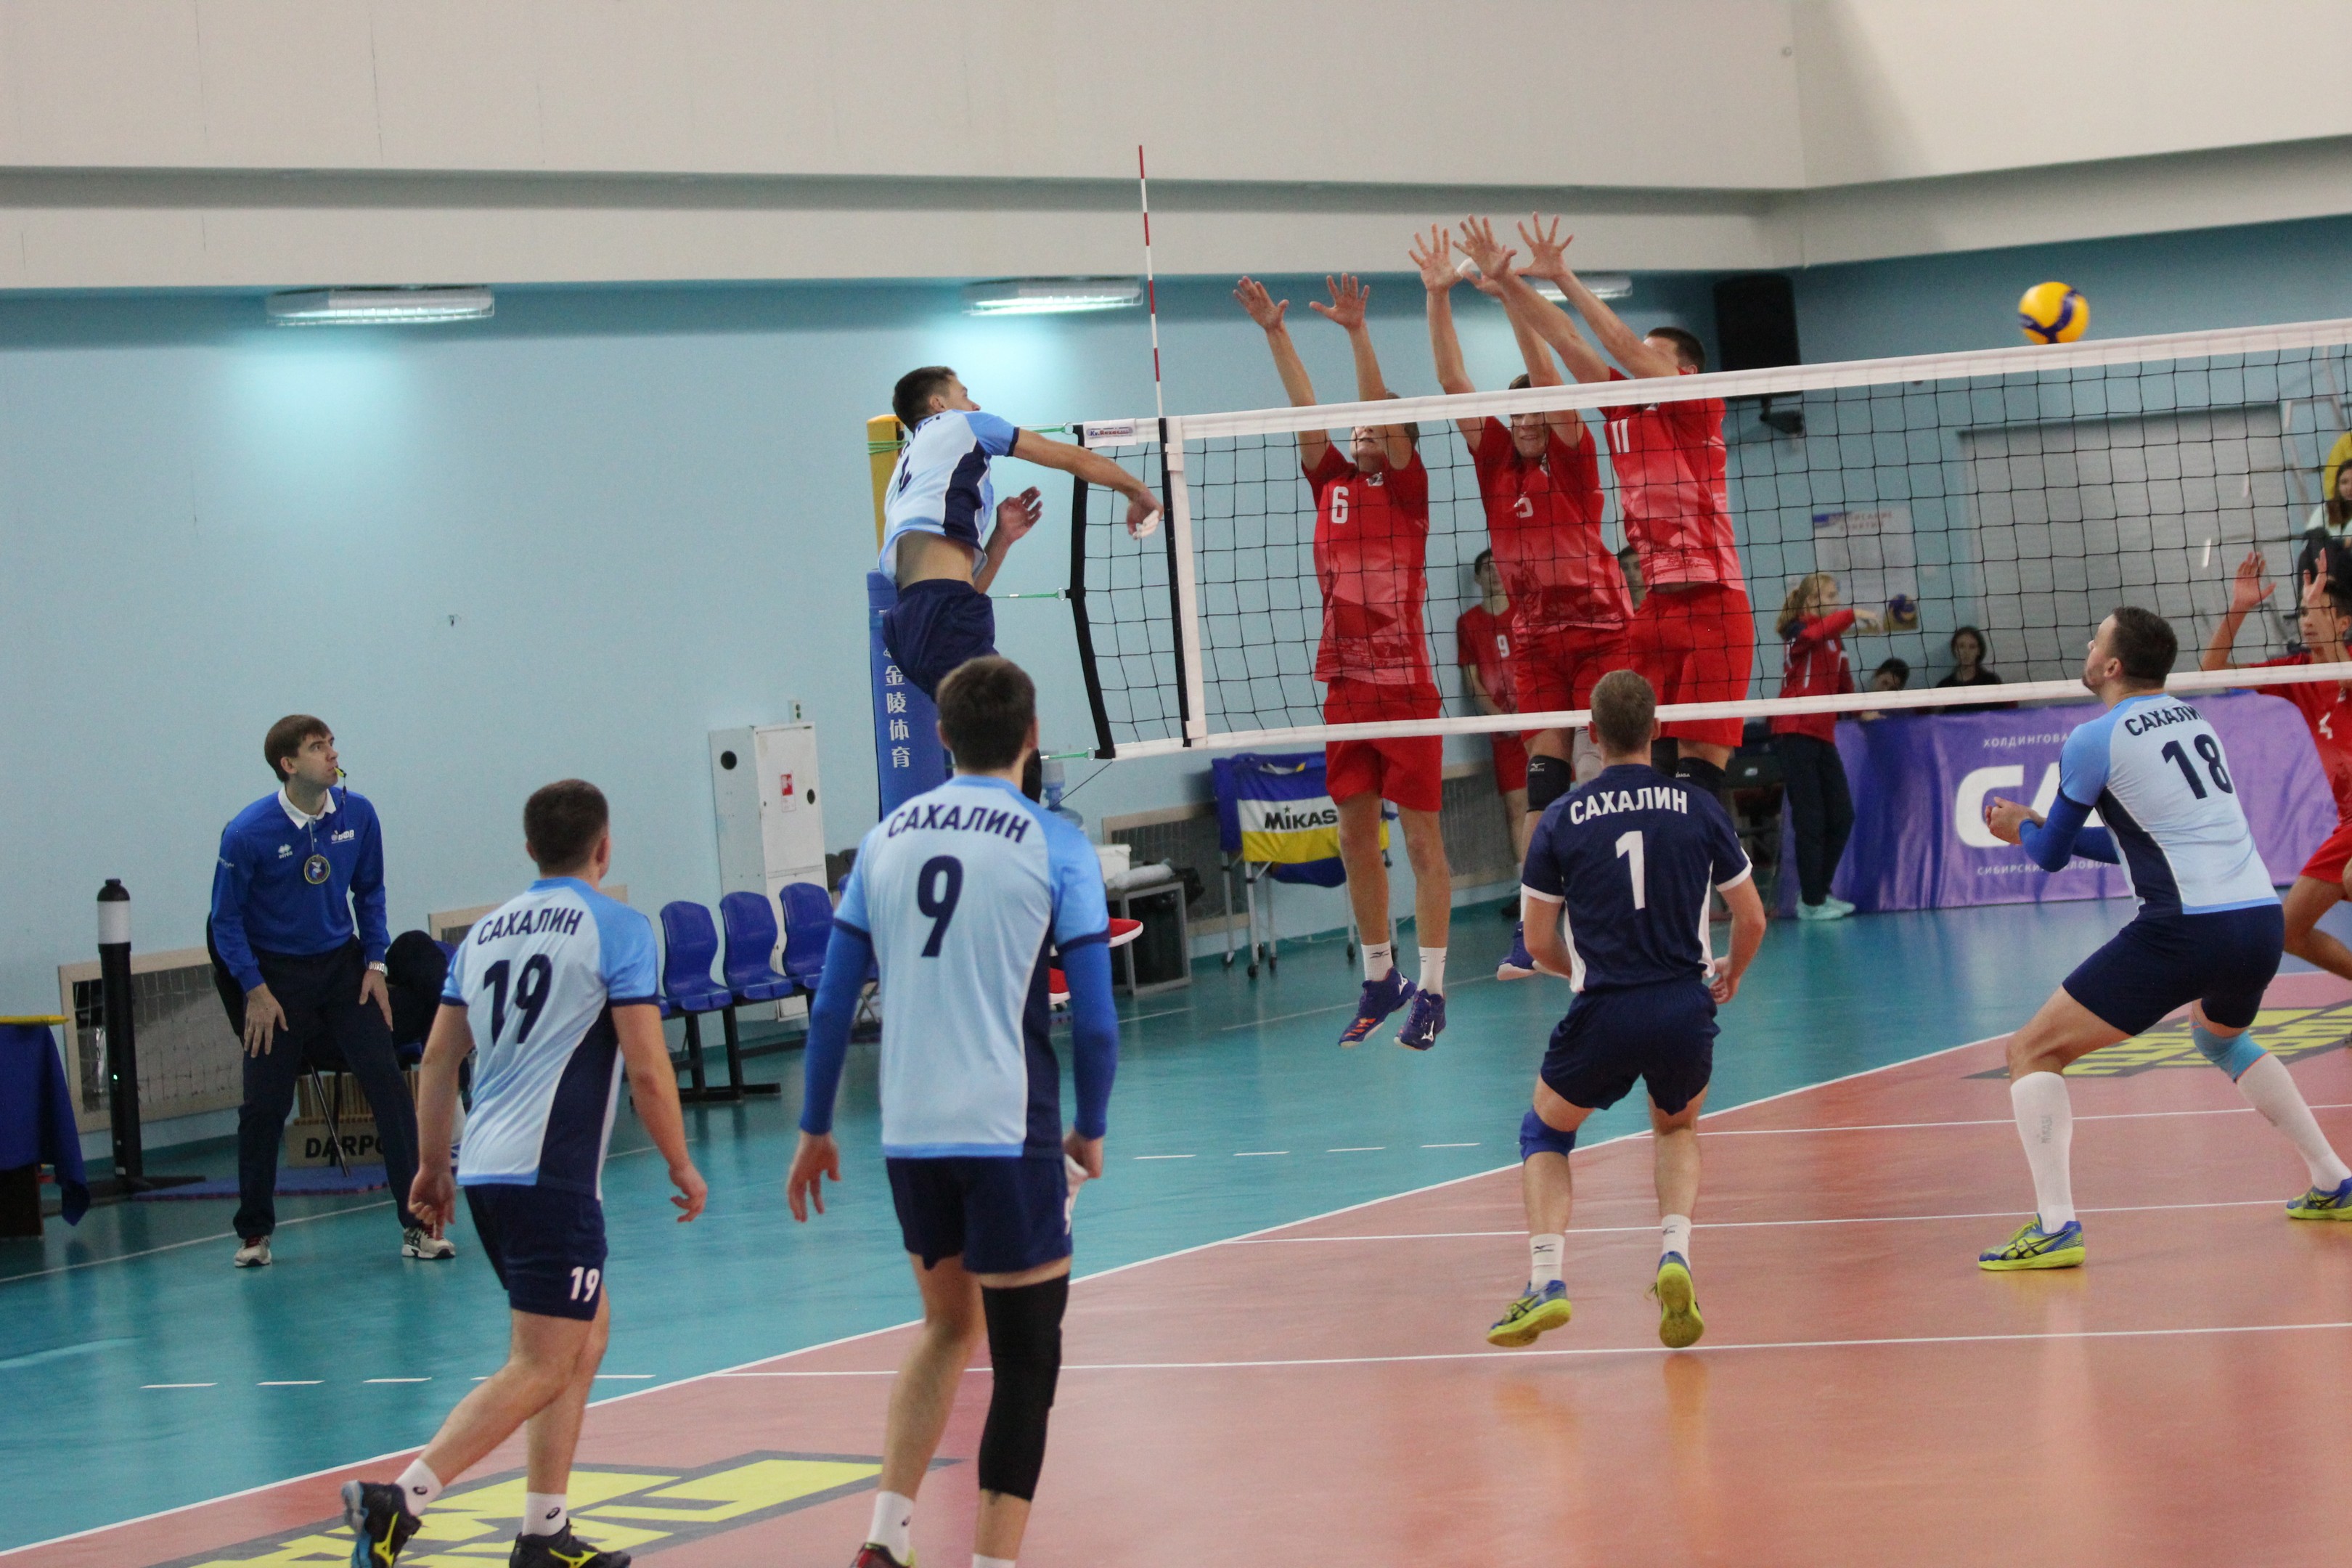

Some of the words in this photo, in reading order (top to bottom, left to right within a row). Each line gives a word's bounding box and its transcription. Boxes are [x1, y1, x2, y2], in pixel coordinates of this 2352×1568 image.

[1610, 417, 1630, 454] 11
[1331, 486, 1349, 524] 6
[1496, 634, 1510, 658] 9
[885, 665, 911, 768] 金陵体育
[2125, 706, 2204, 736] САХАЛИ
[1983, 733, 2069, 748] ХОЛДИНГОВА
[2161, 734, 2234, 799] 18
[888, 804, 1031, 844] САХАЛИН
[1265, 807, 1339, 830] MiKAS
[1570, 786, 1688, 825] САХАЛИН
[1615, 830, 1646, 910] 1
[1977, 864, 2046, 875] СИБИРСКИ
[917, 854, 964, 957] 9
[478, 907, 584, 945] САХАЛИН
[483, 953, 552, 1045] 19
[571, 1266, 600, 1302] 19
